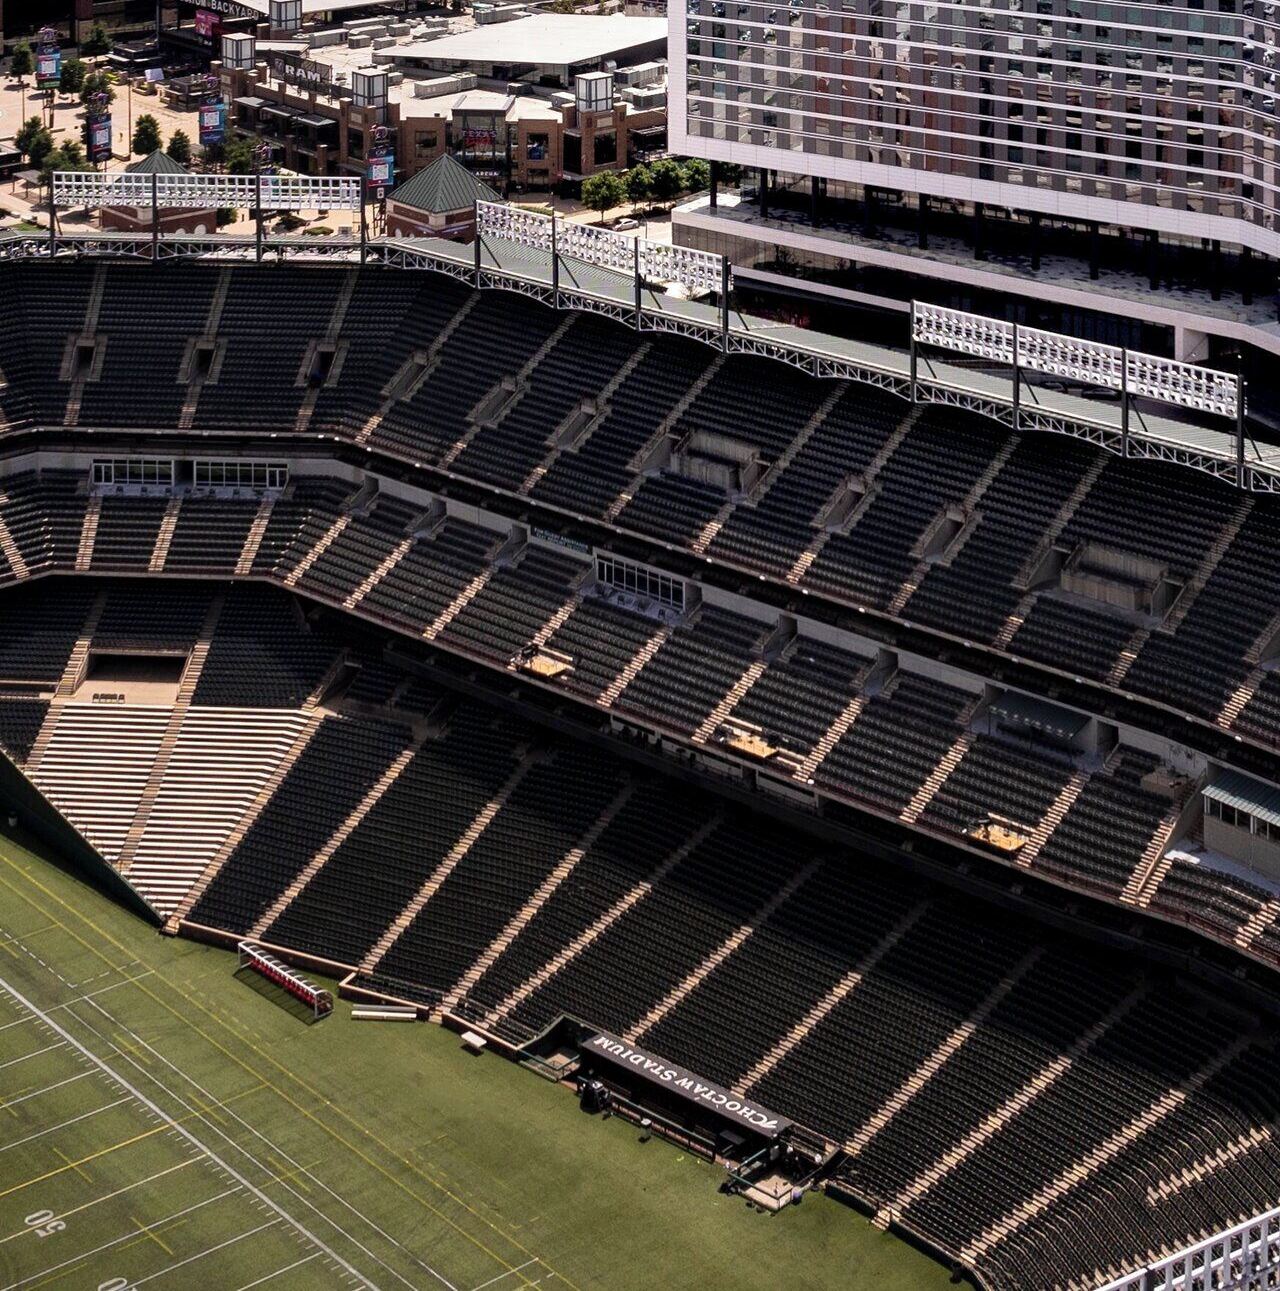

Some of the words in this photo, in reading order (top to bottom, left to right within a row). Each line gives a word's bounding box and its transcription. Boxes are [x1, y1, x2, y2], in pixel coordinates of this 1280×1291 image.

[211, 0, 258, 21] BACKYARD
[285, 64, 320, 82] RAM
[462, 130, 497, 138] TEXAS
[594, 1036, 677, 1081] STADIUM
[675, 1077, 767, 1125] CHOCTAW
[24, 1210, 66, 1237] 50
